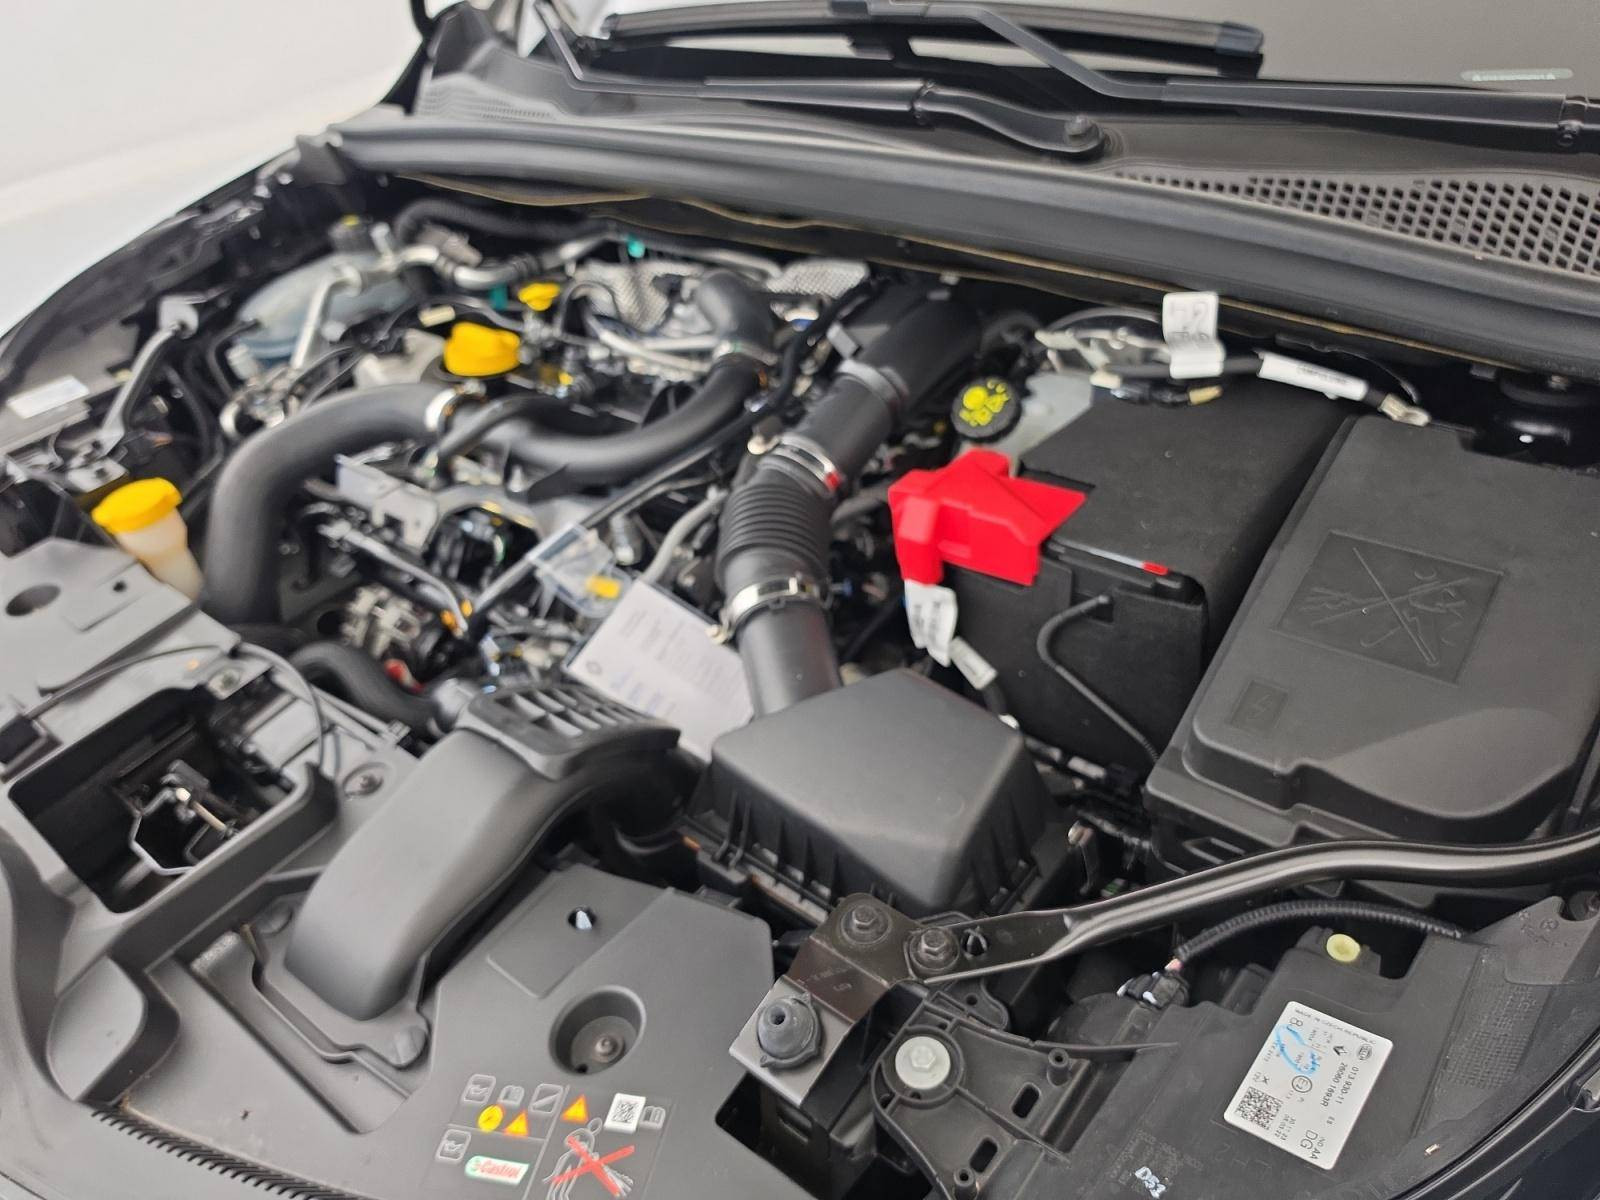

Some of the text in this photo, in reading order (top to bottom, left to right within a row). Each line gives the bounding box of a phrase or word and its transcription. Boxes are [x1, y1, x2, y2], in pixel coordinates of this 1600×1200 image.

[1318, 1061, 1348, 1107] 26060 1693R
[1346, 1065, 1360, 1081] 013
[1334, 1079, 1353, 1105] 930-11
[1298, 1128, 1318, 1151] DG
